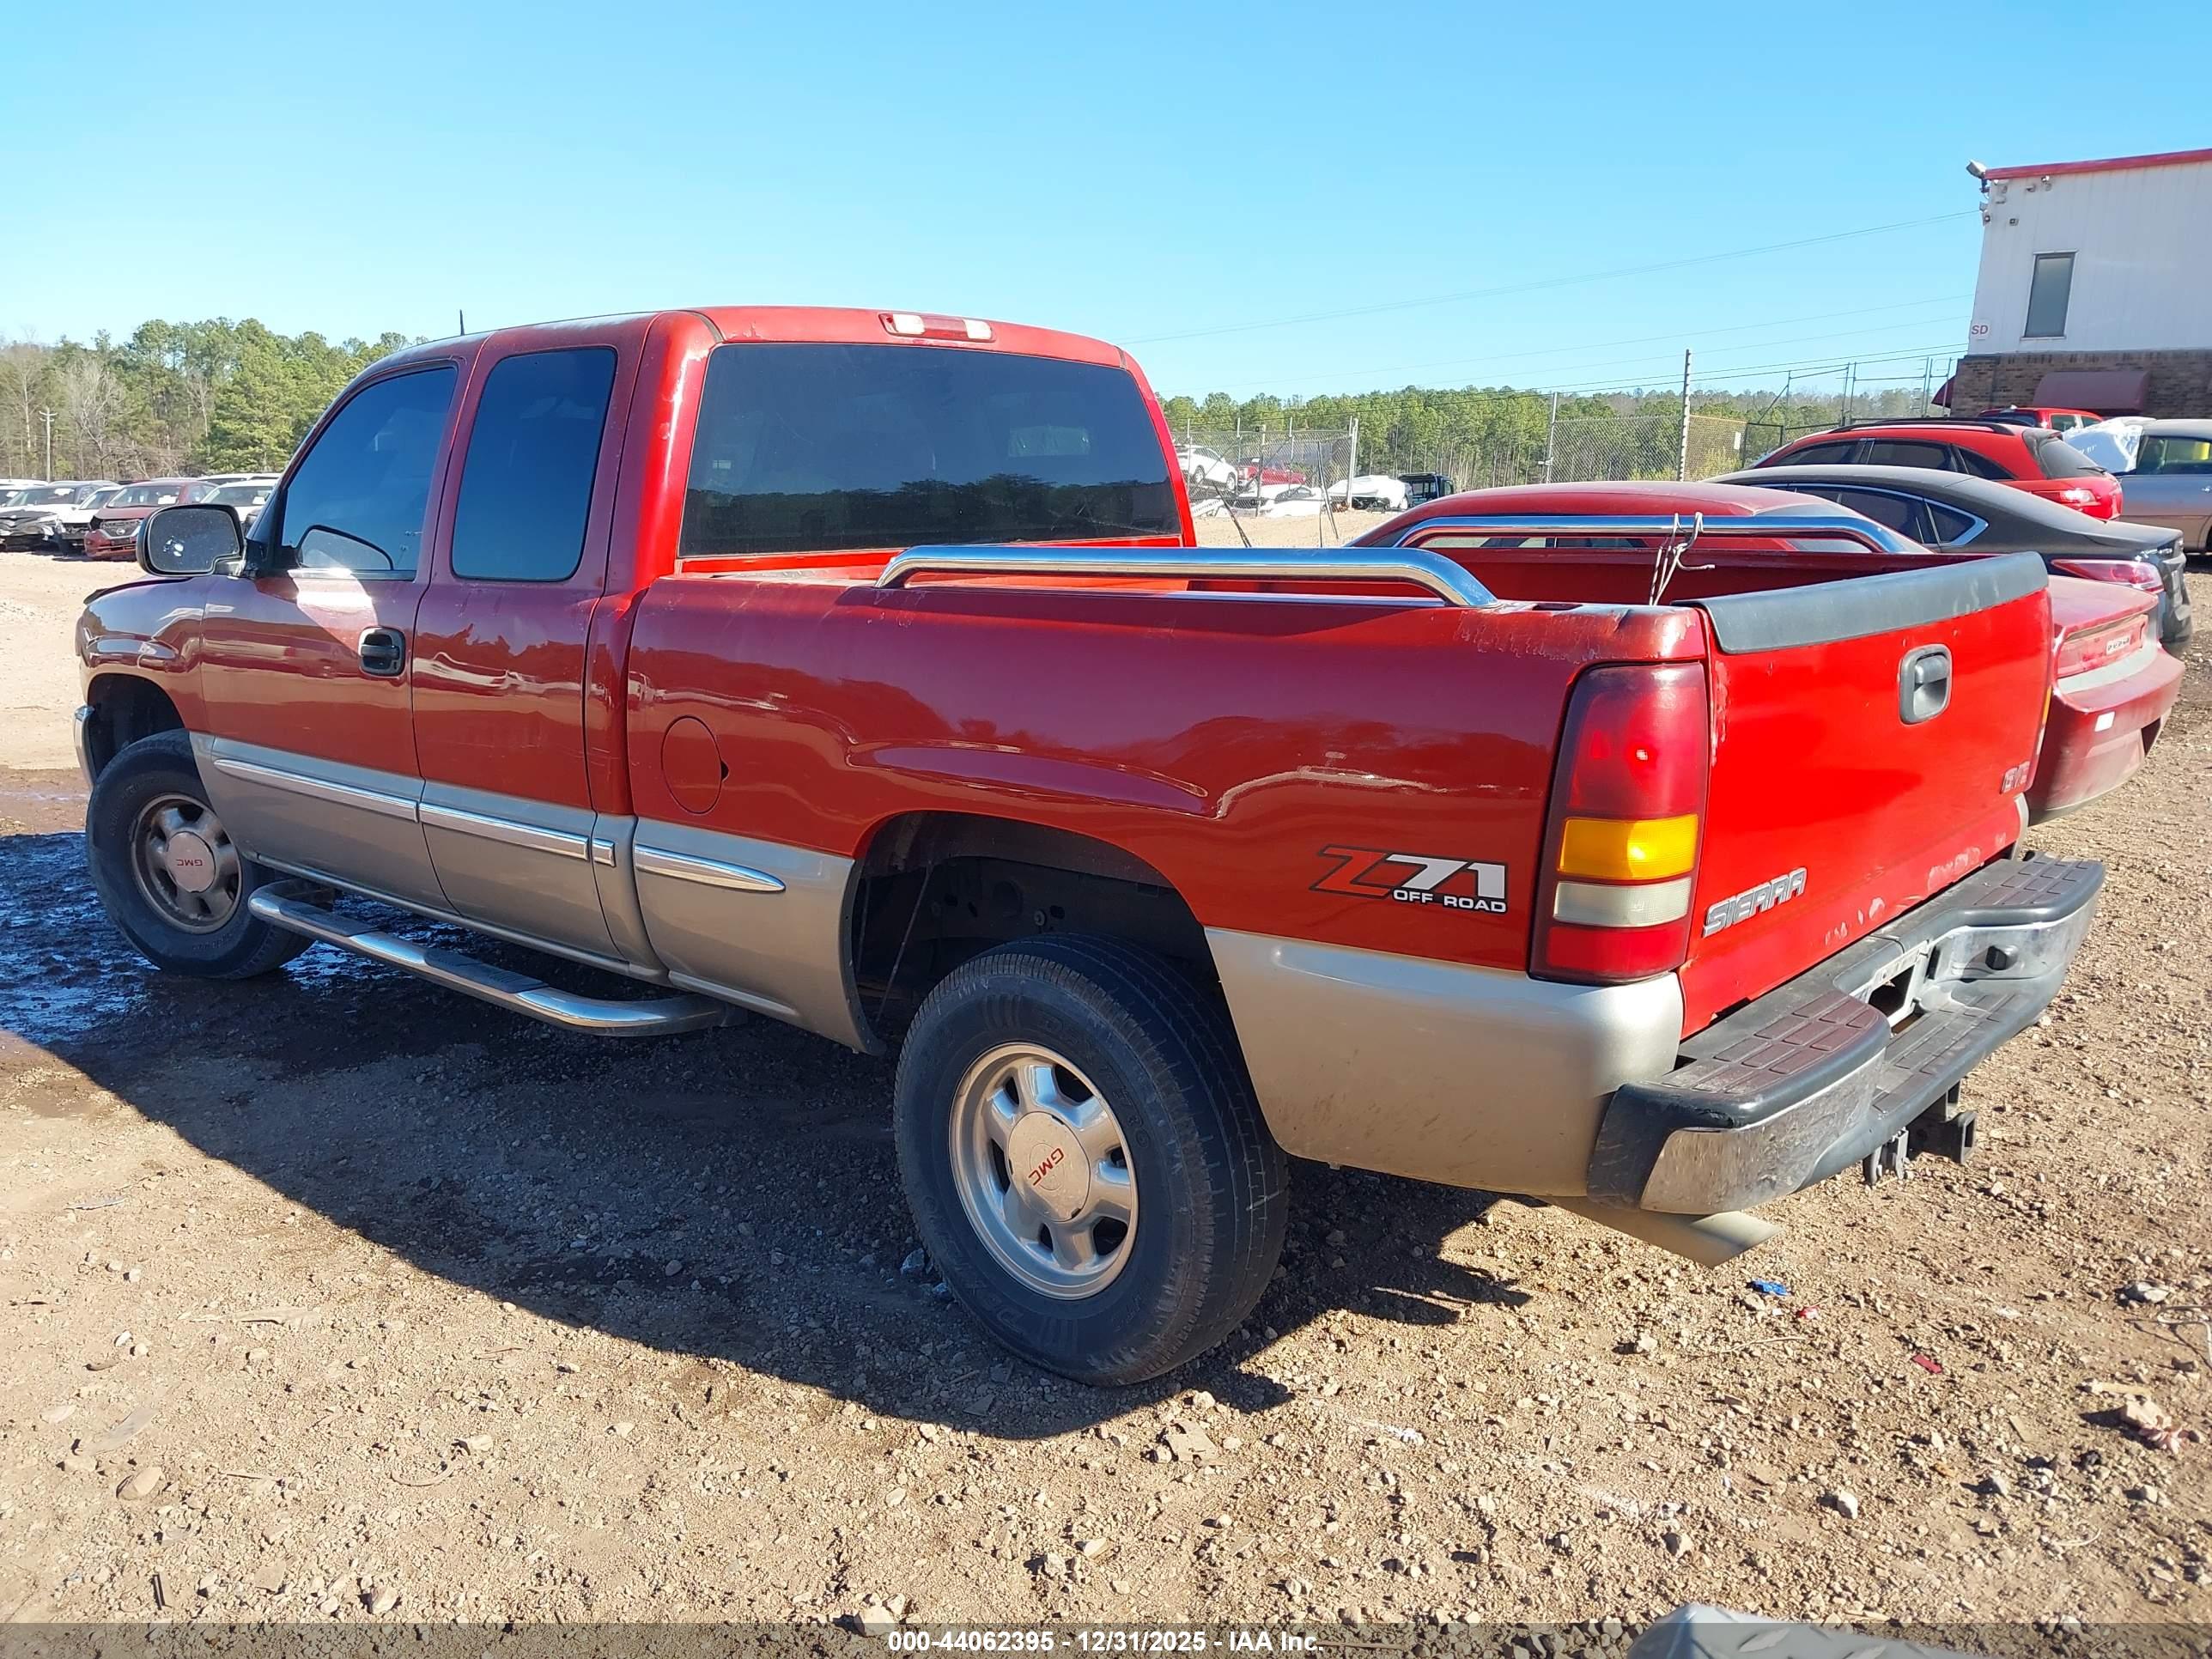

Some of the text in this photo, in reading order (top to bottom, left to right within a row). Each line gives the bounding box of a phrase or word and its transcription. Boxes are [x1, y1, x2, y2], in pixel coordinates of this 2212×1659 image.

[1971, 325, 1989, 335] SD
[1310, 845, 1506, 899] Z71
[1393, 889, 1507, 913] OFF ROAD
[1703, 866, 1808, 938] SIERRA
[1028, 1147, 1064, 1186] GMC
